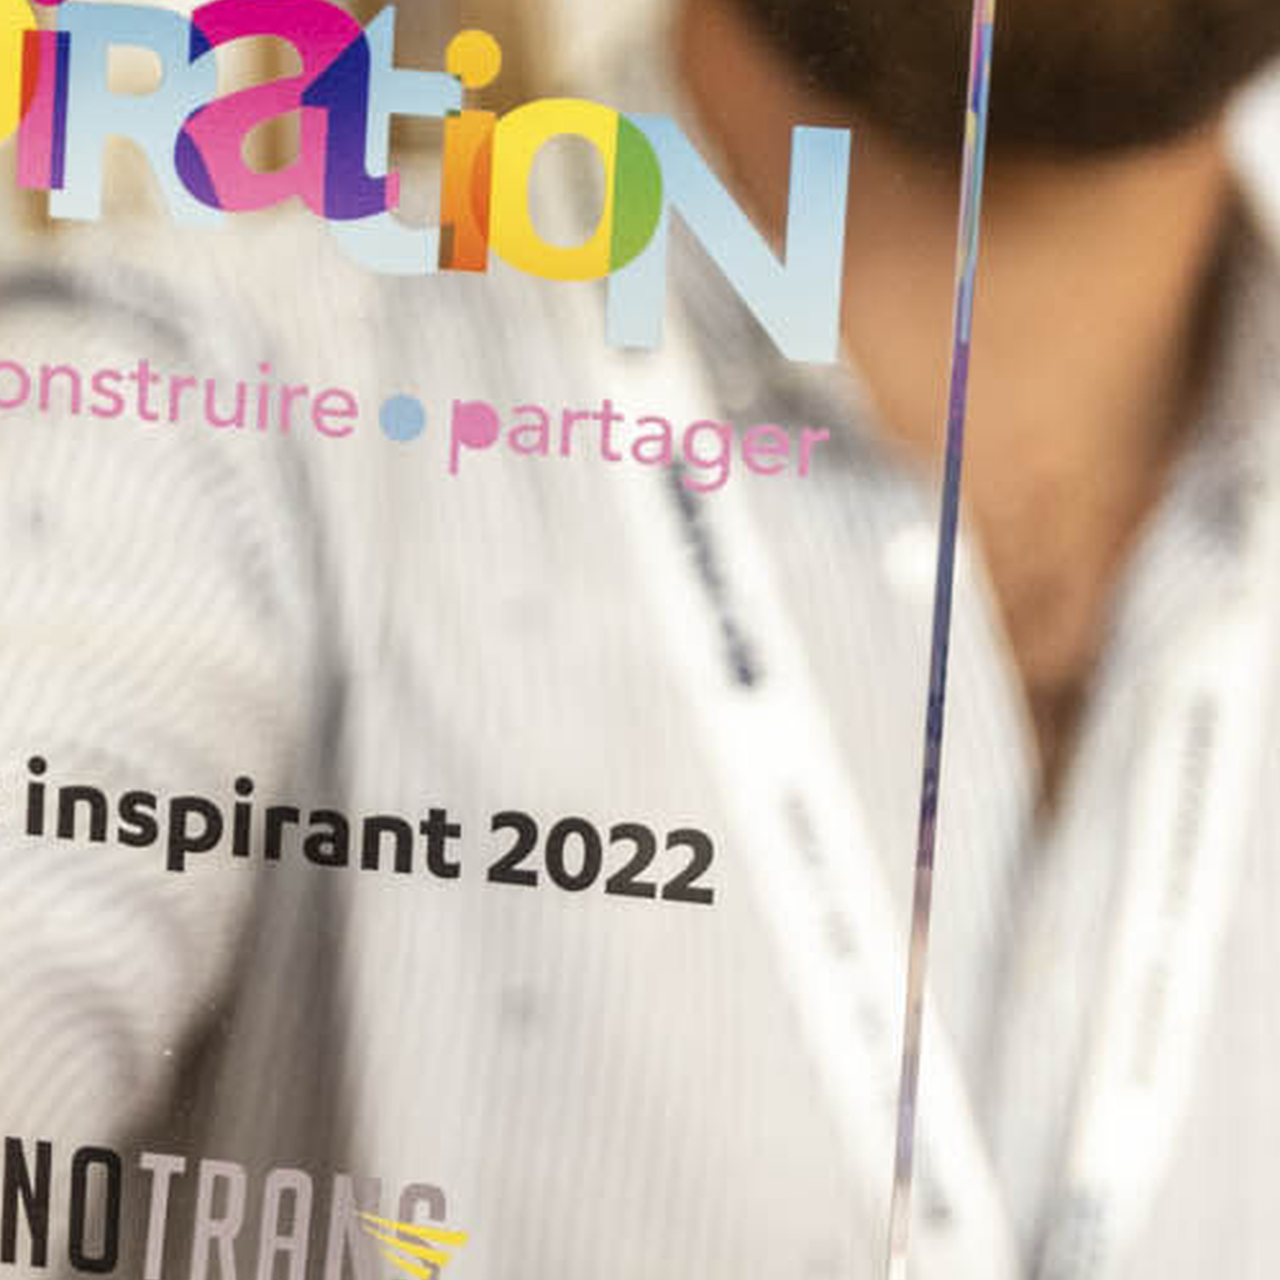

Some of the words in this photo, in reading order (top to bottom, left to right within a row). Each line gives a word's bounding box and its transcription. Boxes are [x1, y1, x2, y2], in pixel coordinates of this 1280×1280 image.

[448, 397, 831, 493] partager
[24, 757, 464, 880] inspirant
[486, 811, 717, 904] 2022
